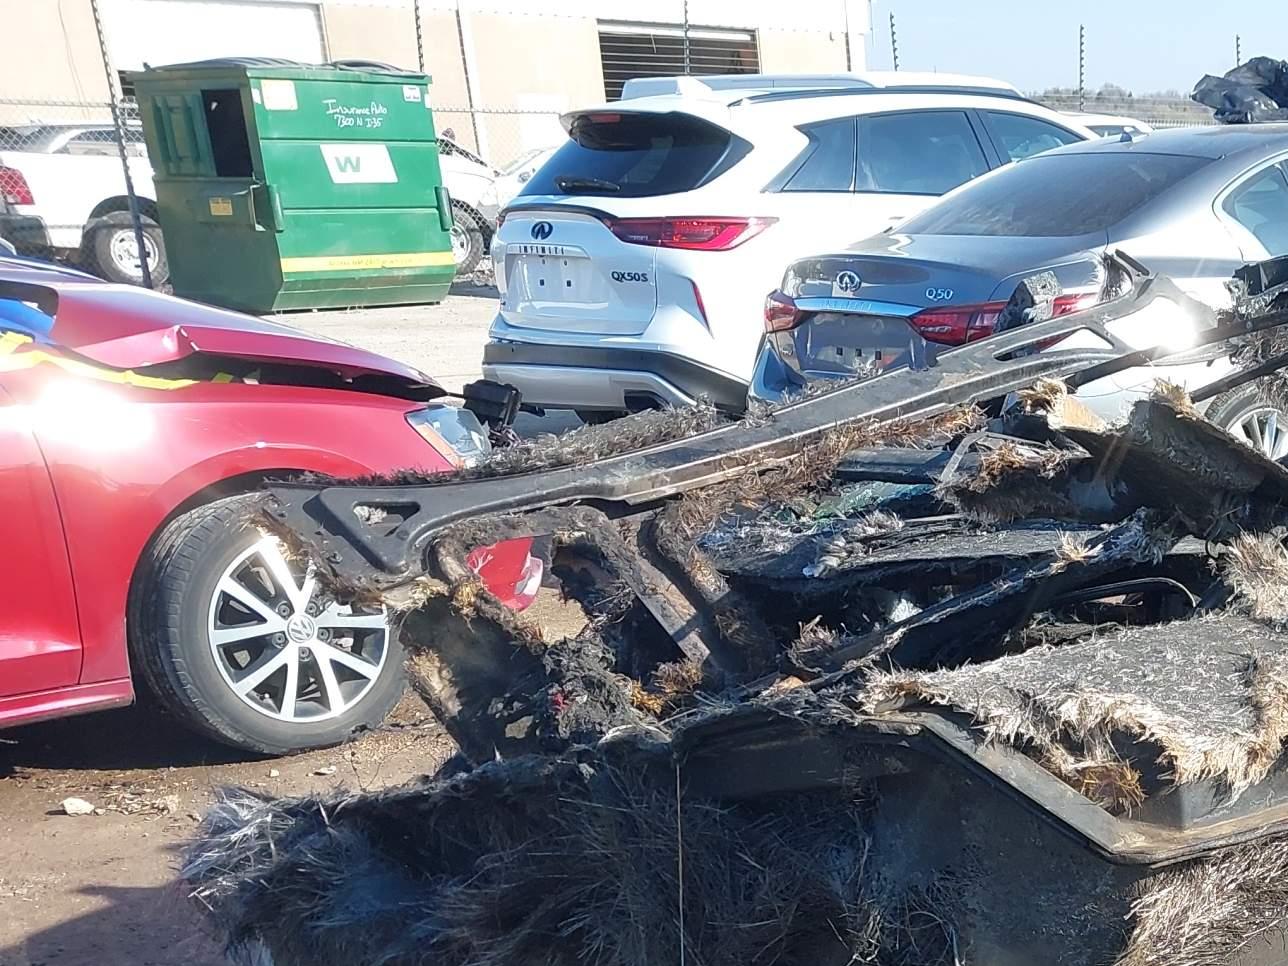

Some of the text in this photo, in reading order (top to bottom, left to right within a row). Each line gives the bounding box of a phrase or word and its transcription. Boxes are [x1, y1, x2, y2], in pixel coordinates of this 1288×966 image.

[334, 114, 355, 128] 7300
[356, 117, 363, 126] N
[518, 245, 565, 255] INFINITI
[925, 287, 954, 301] Q50
